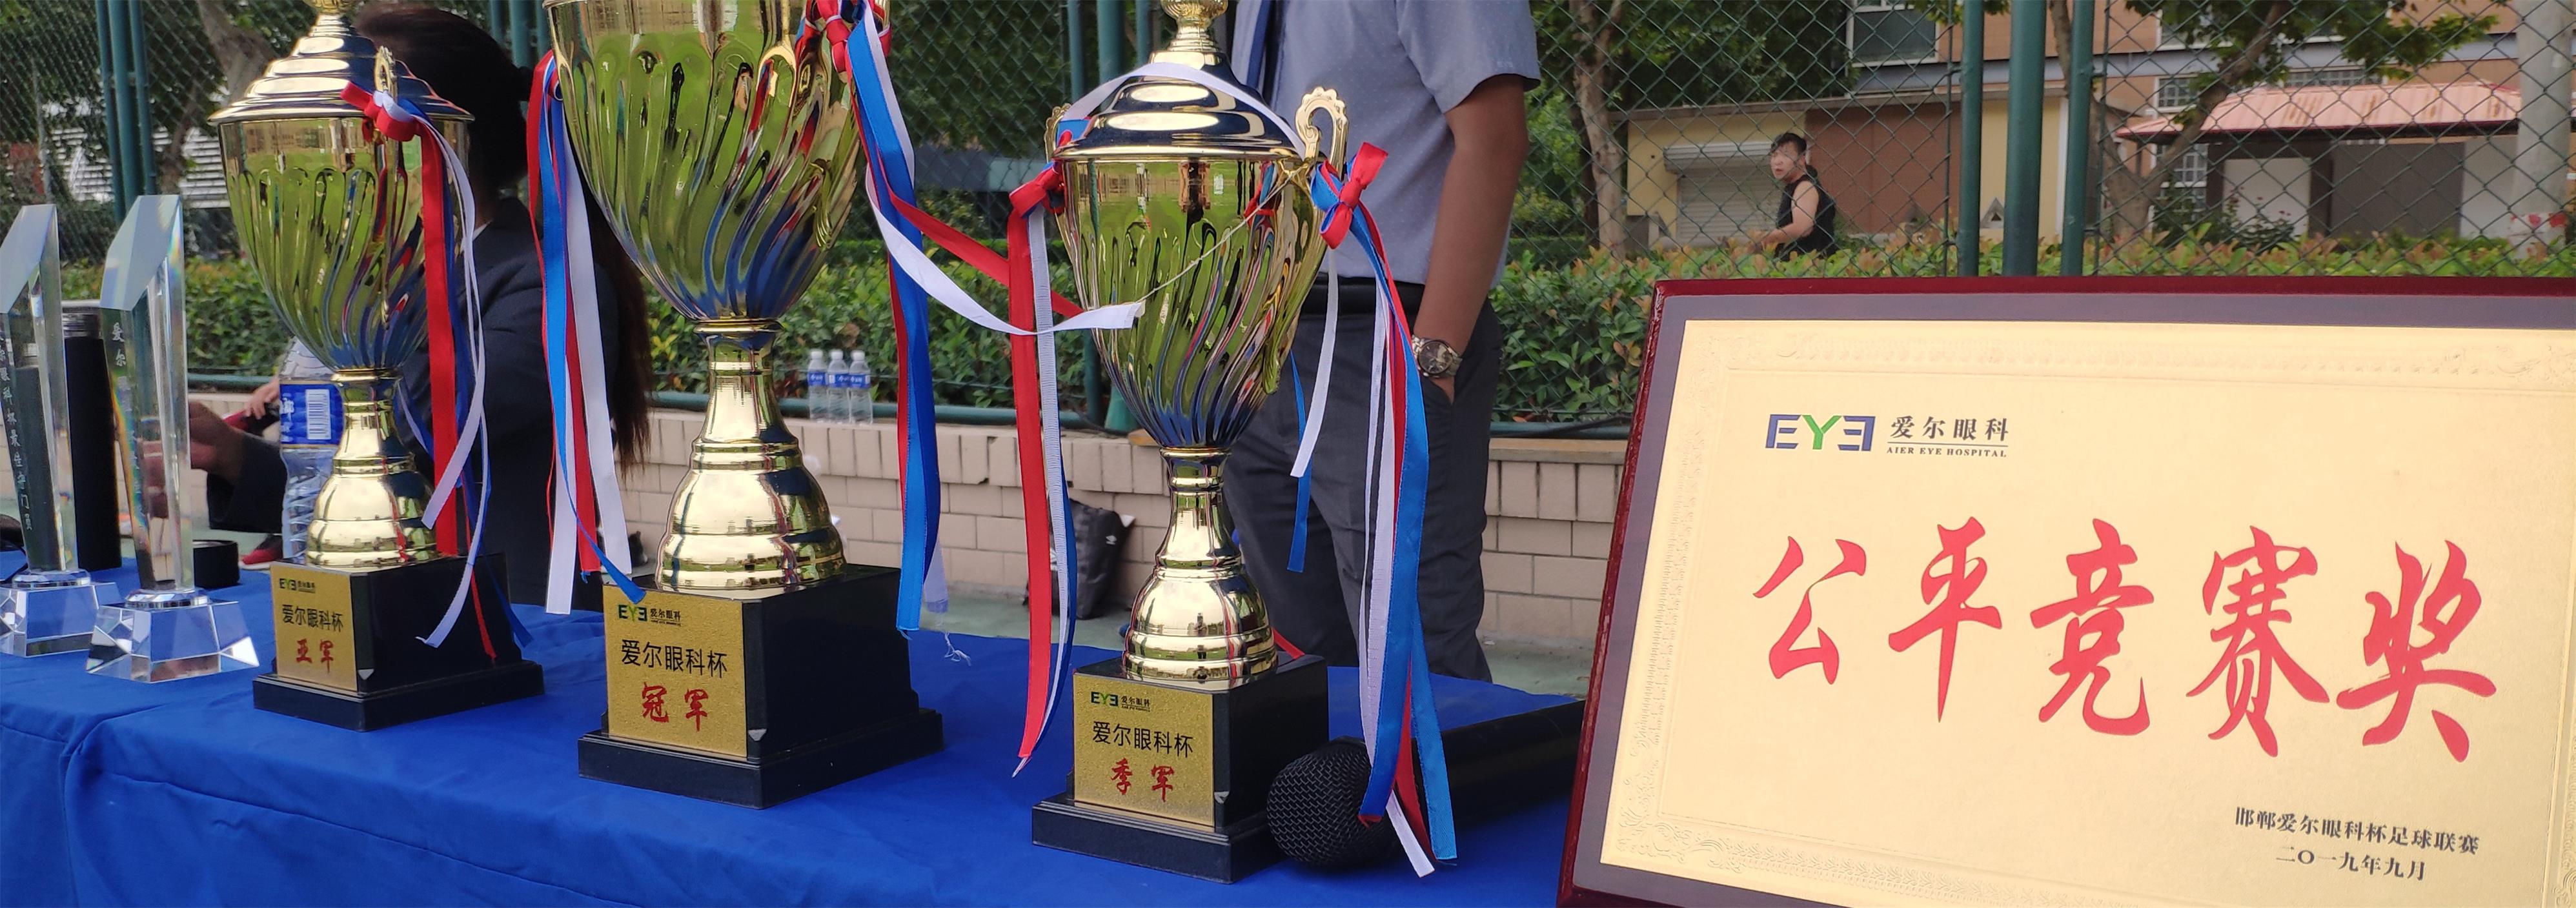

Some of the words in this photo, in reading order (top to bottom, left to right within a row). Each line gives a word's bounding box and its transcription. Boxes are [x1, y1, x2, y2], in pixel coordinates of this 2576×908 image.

[1765, 414, 1876, 452] EYE
[1890, 415, 2009, 442] 爱尔眼科
[1919, 447, 1942, 456] EYE
[1947, 448, 2007, 458] HOSPITAL
[282, 604, 344, 632] 爱尔眼科杯
[618, 604, 648, 622] EYE
[295, 638, 335, 673] 亚军
[1752, 516, 2497, 763] 公平竞赛奖
[621, 639, 727, 679] 爱尔眼科杯
[641, 681, 709, 732] 冠军
[1090, 691, 1119, 707] EYE
[1092, 720, 1193, 759] 爱尔眼科杯
[1110, 758, 1175, 803] 季军
[2235, 806, 2480, 856] 邯郸爱尔眼科杯足球联赛
